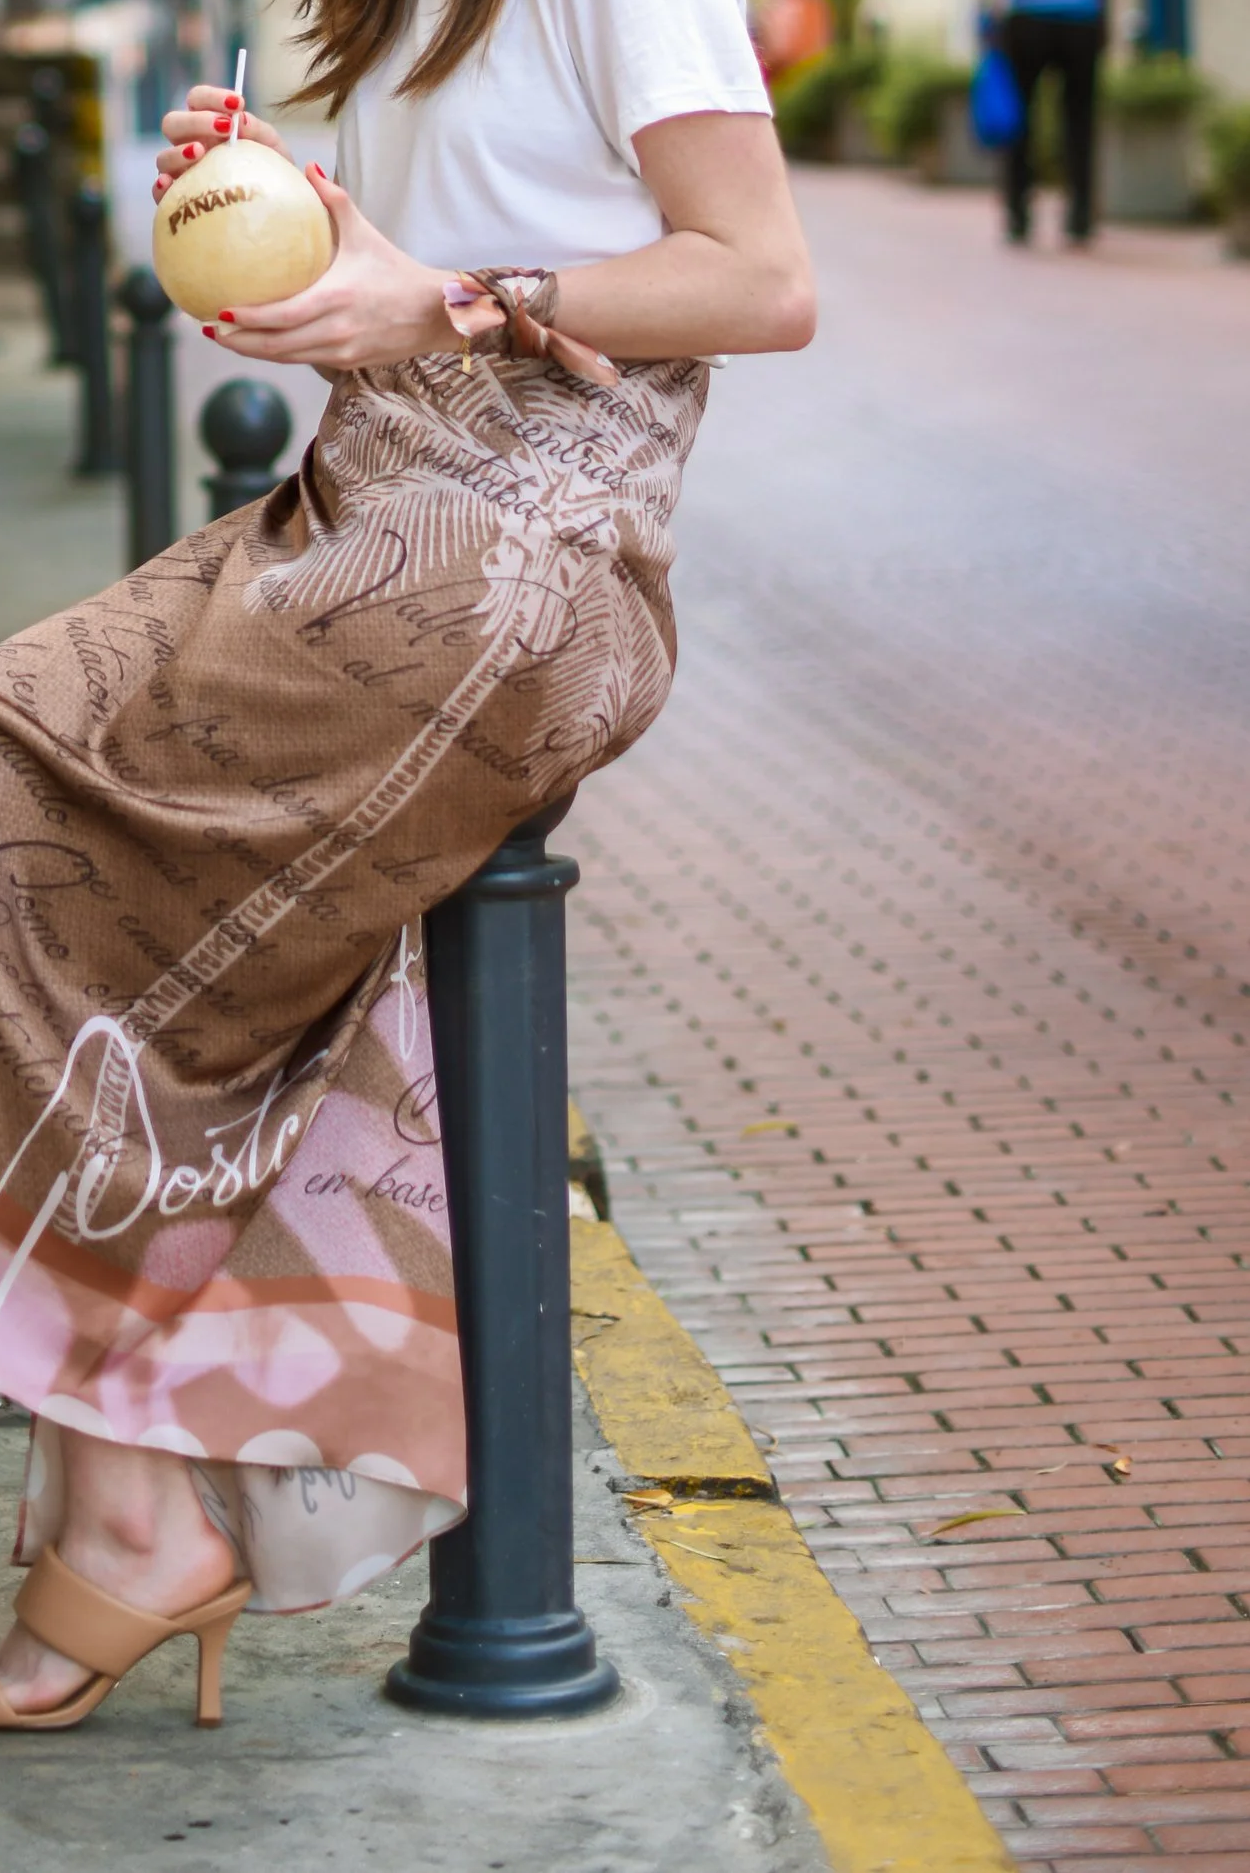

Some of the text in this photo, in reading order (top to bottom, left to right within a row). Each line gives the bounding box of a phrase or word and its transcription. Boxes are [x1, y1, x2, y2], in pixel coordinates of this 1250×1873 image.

[168, 184, 265, 236] PANAMA
[475, 405, 638, 491] mientras
[392, 441, 559, 523] pintaba
[556, 513, 614, 557] de
[304, 1155, 449, 1213] en base
